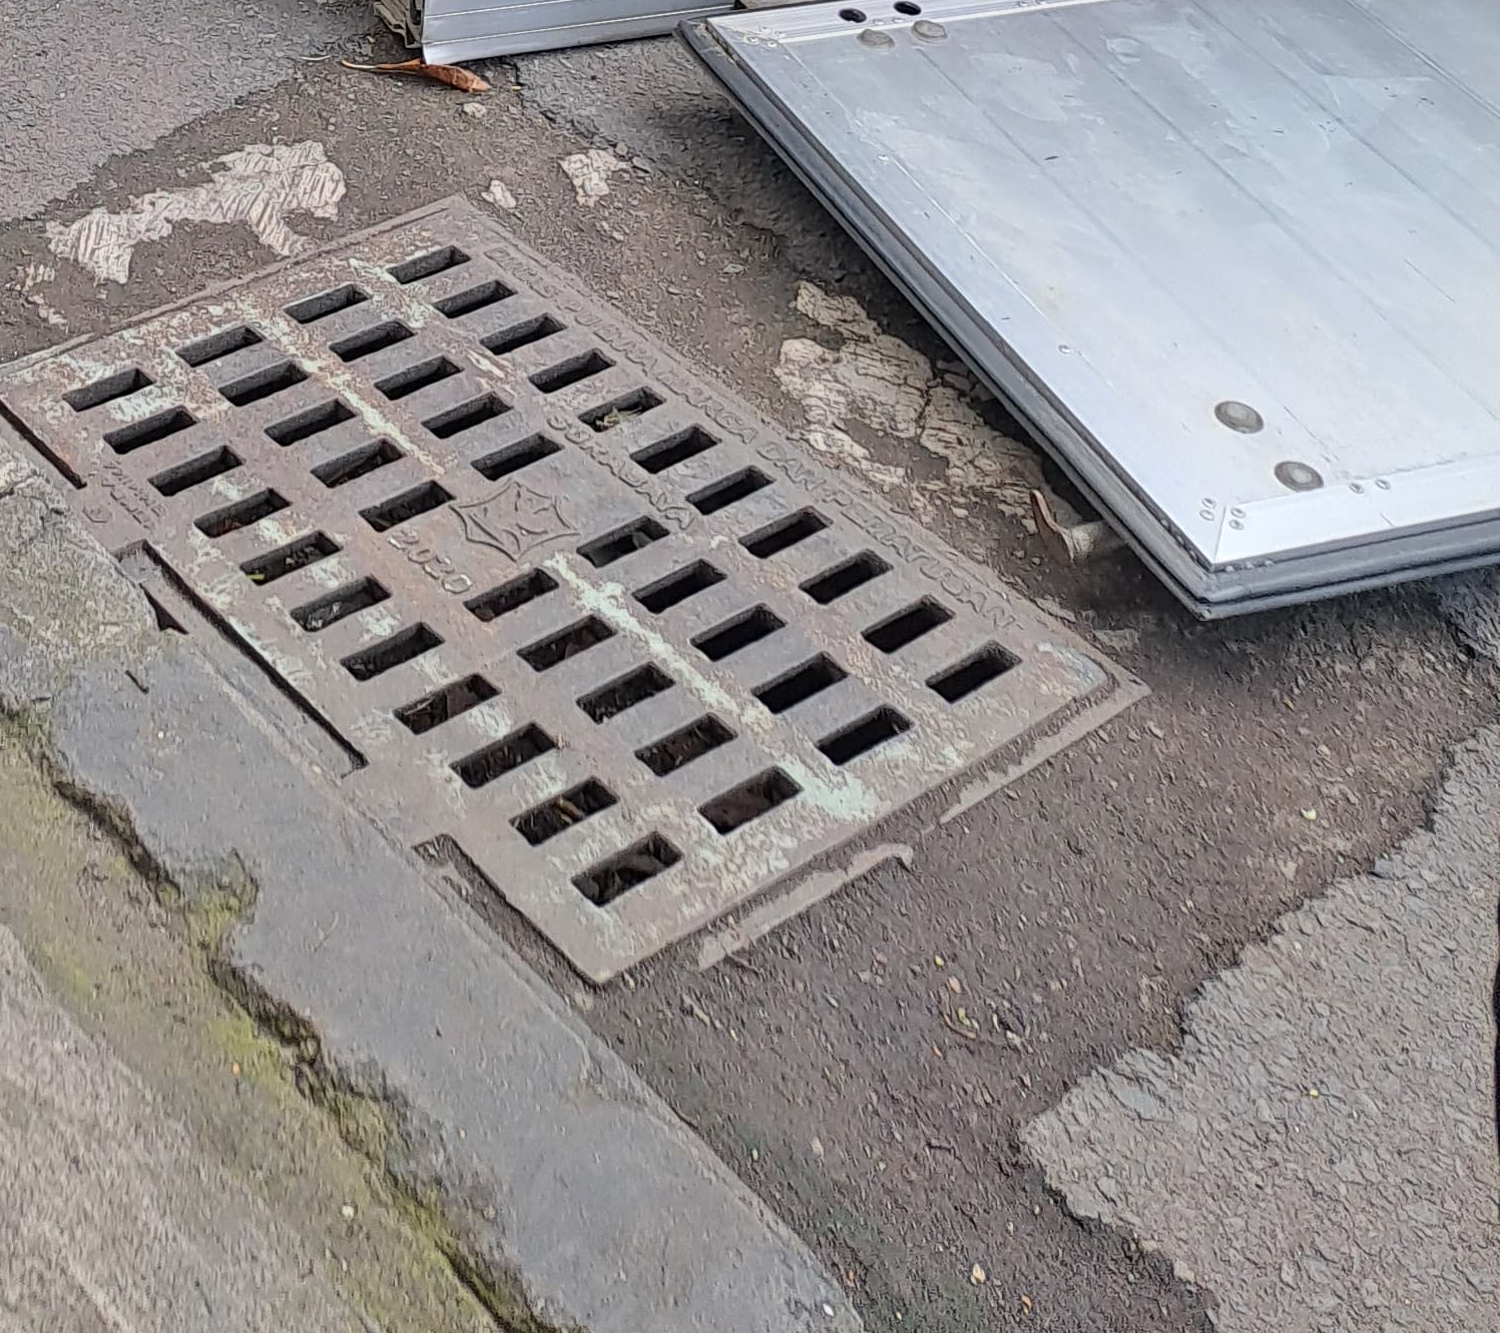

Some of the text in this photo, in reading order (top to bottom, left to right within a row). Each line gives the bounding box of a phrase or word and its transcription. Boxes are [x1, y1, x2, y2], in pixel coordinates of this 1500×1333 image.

[546, 411, 695, 531] SURABAYA
[756, 440, 826, 492] DAN
[386, 524, 473, 595] 2020
